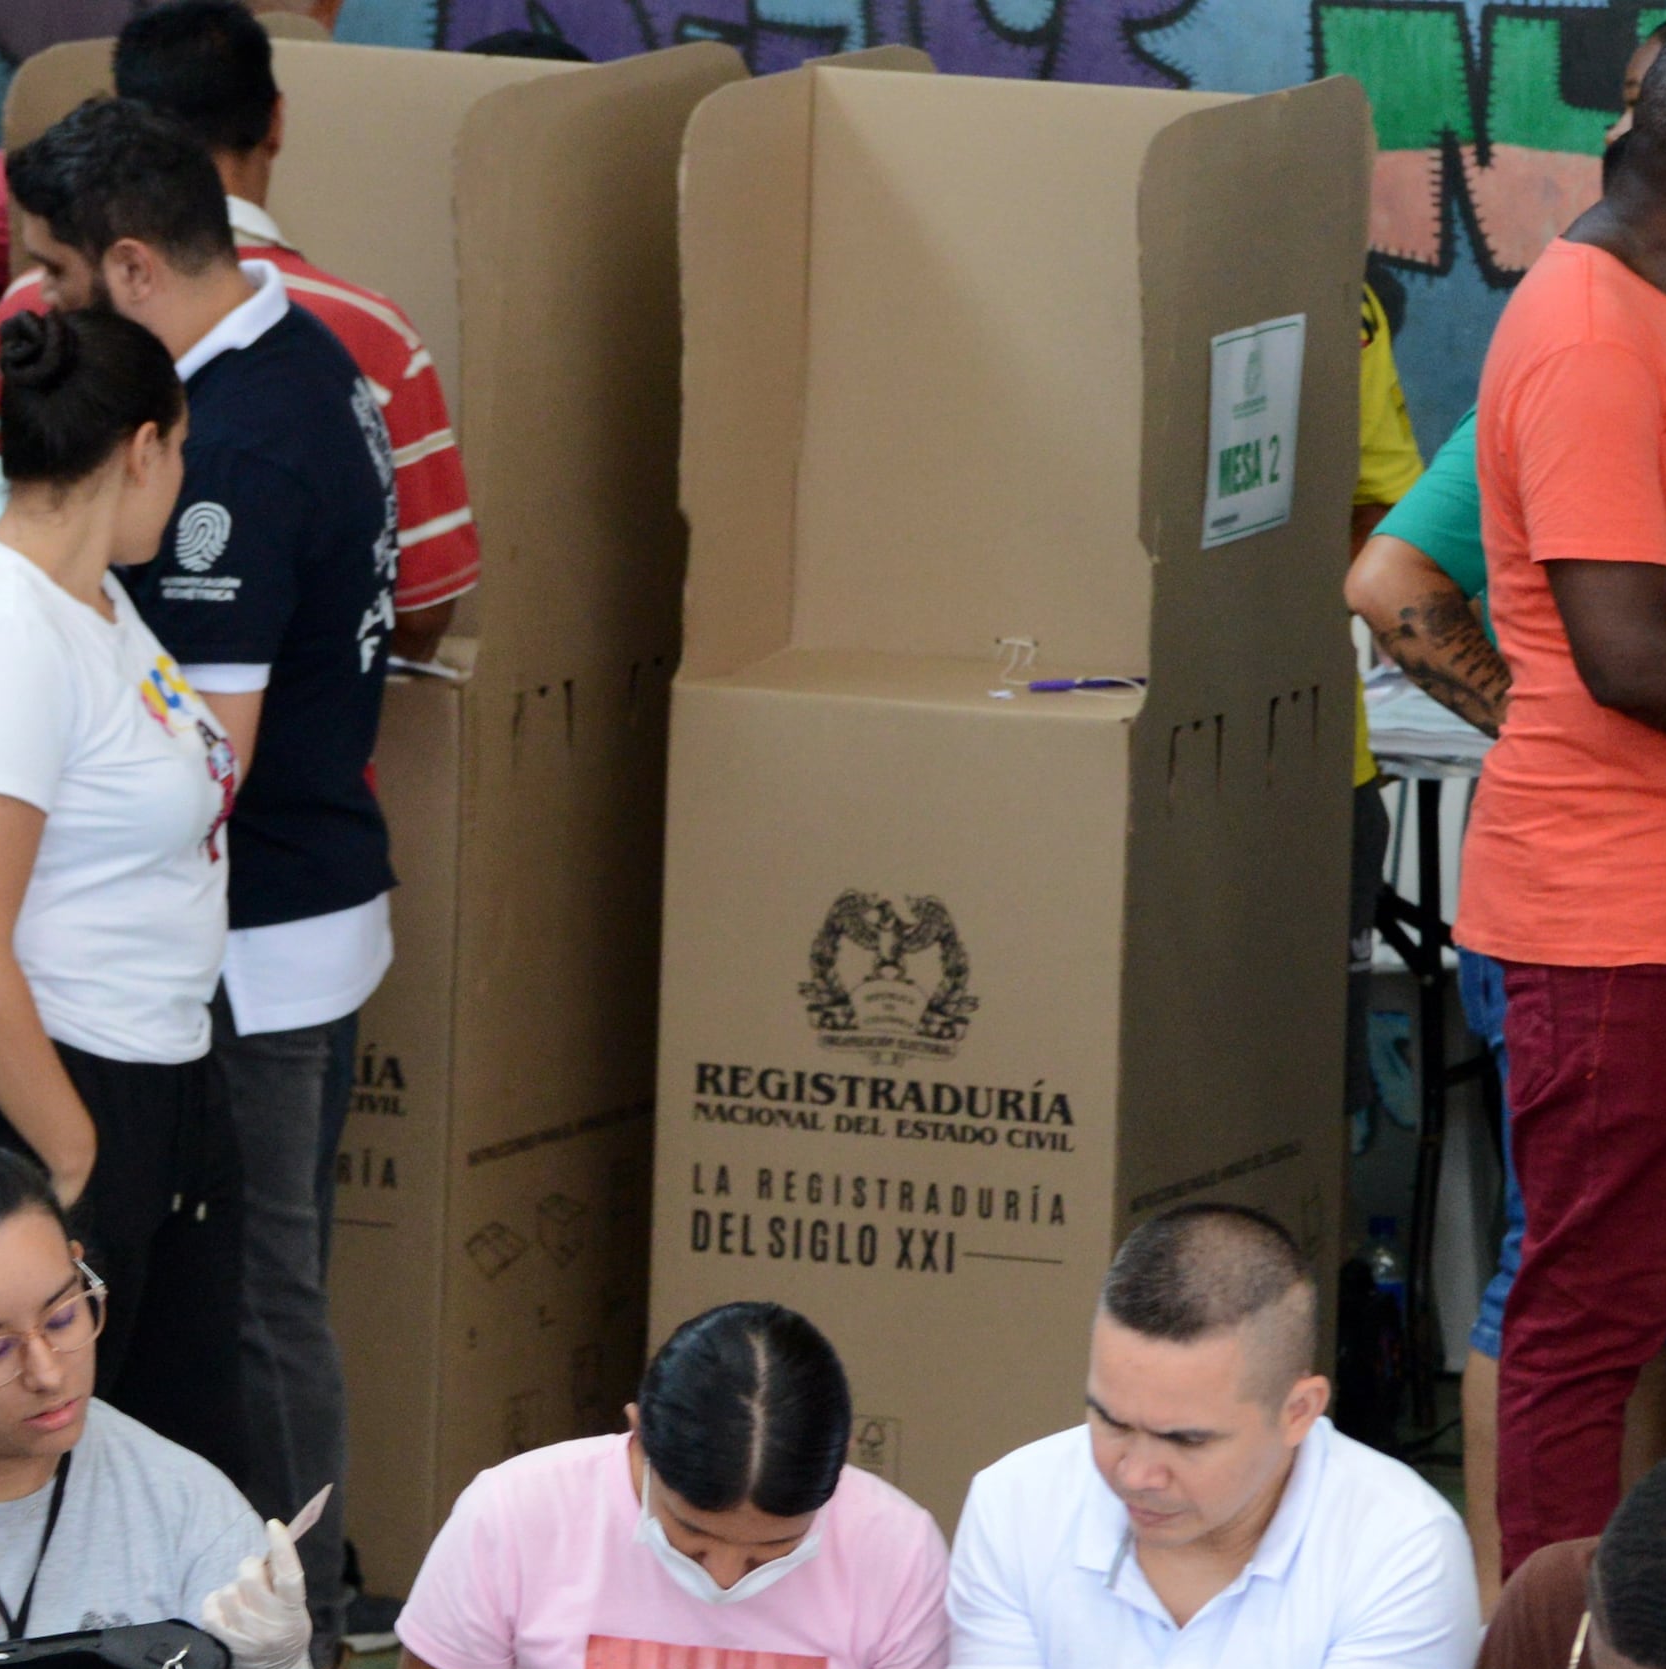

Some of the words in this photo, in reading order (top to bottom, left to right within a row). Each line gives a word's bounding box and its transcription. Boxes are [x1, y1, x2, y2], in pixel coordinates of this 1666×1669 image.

[1218, 438, 1263, 499] MESA
[1268, 434, 1280, 484] 2
[695, 1062, 1075, 1126] REGISTRADURÍA
[693, 1103, 824, 1131] NACIONAL
[835, 1111, 885, 1137] DEL
[896, 1119, 997, 1146] ESTADO
[1006, 1129, 1075, 1152] CIVIL
[693, 1163, 730, 1196] LA
[758, 1168, 1066, 1226] REGISTRADURÍA
[692, 1209, 756, 1256] DEL
[768, 1216, 878, 1266] SIGLO
[896, 1227, 955, 1273] XXI
